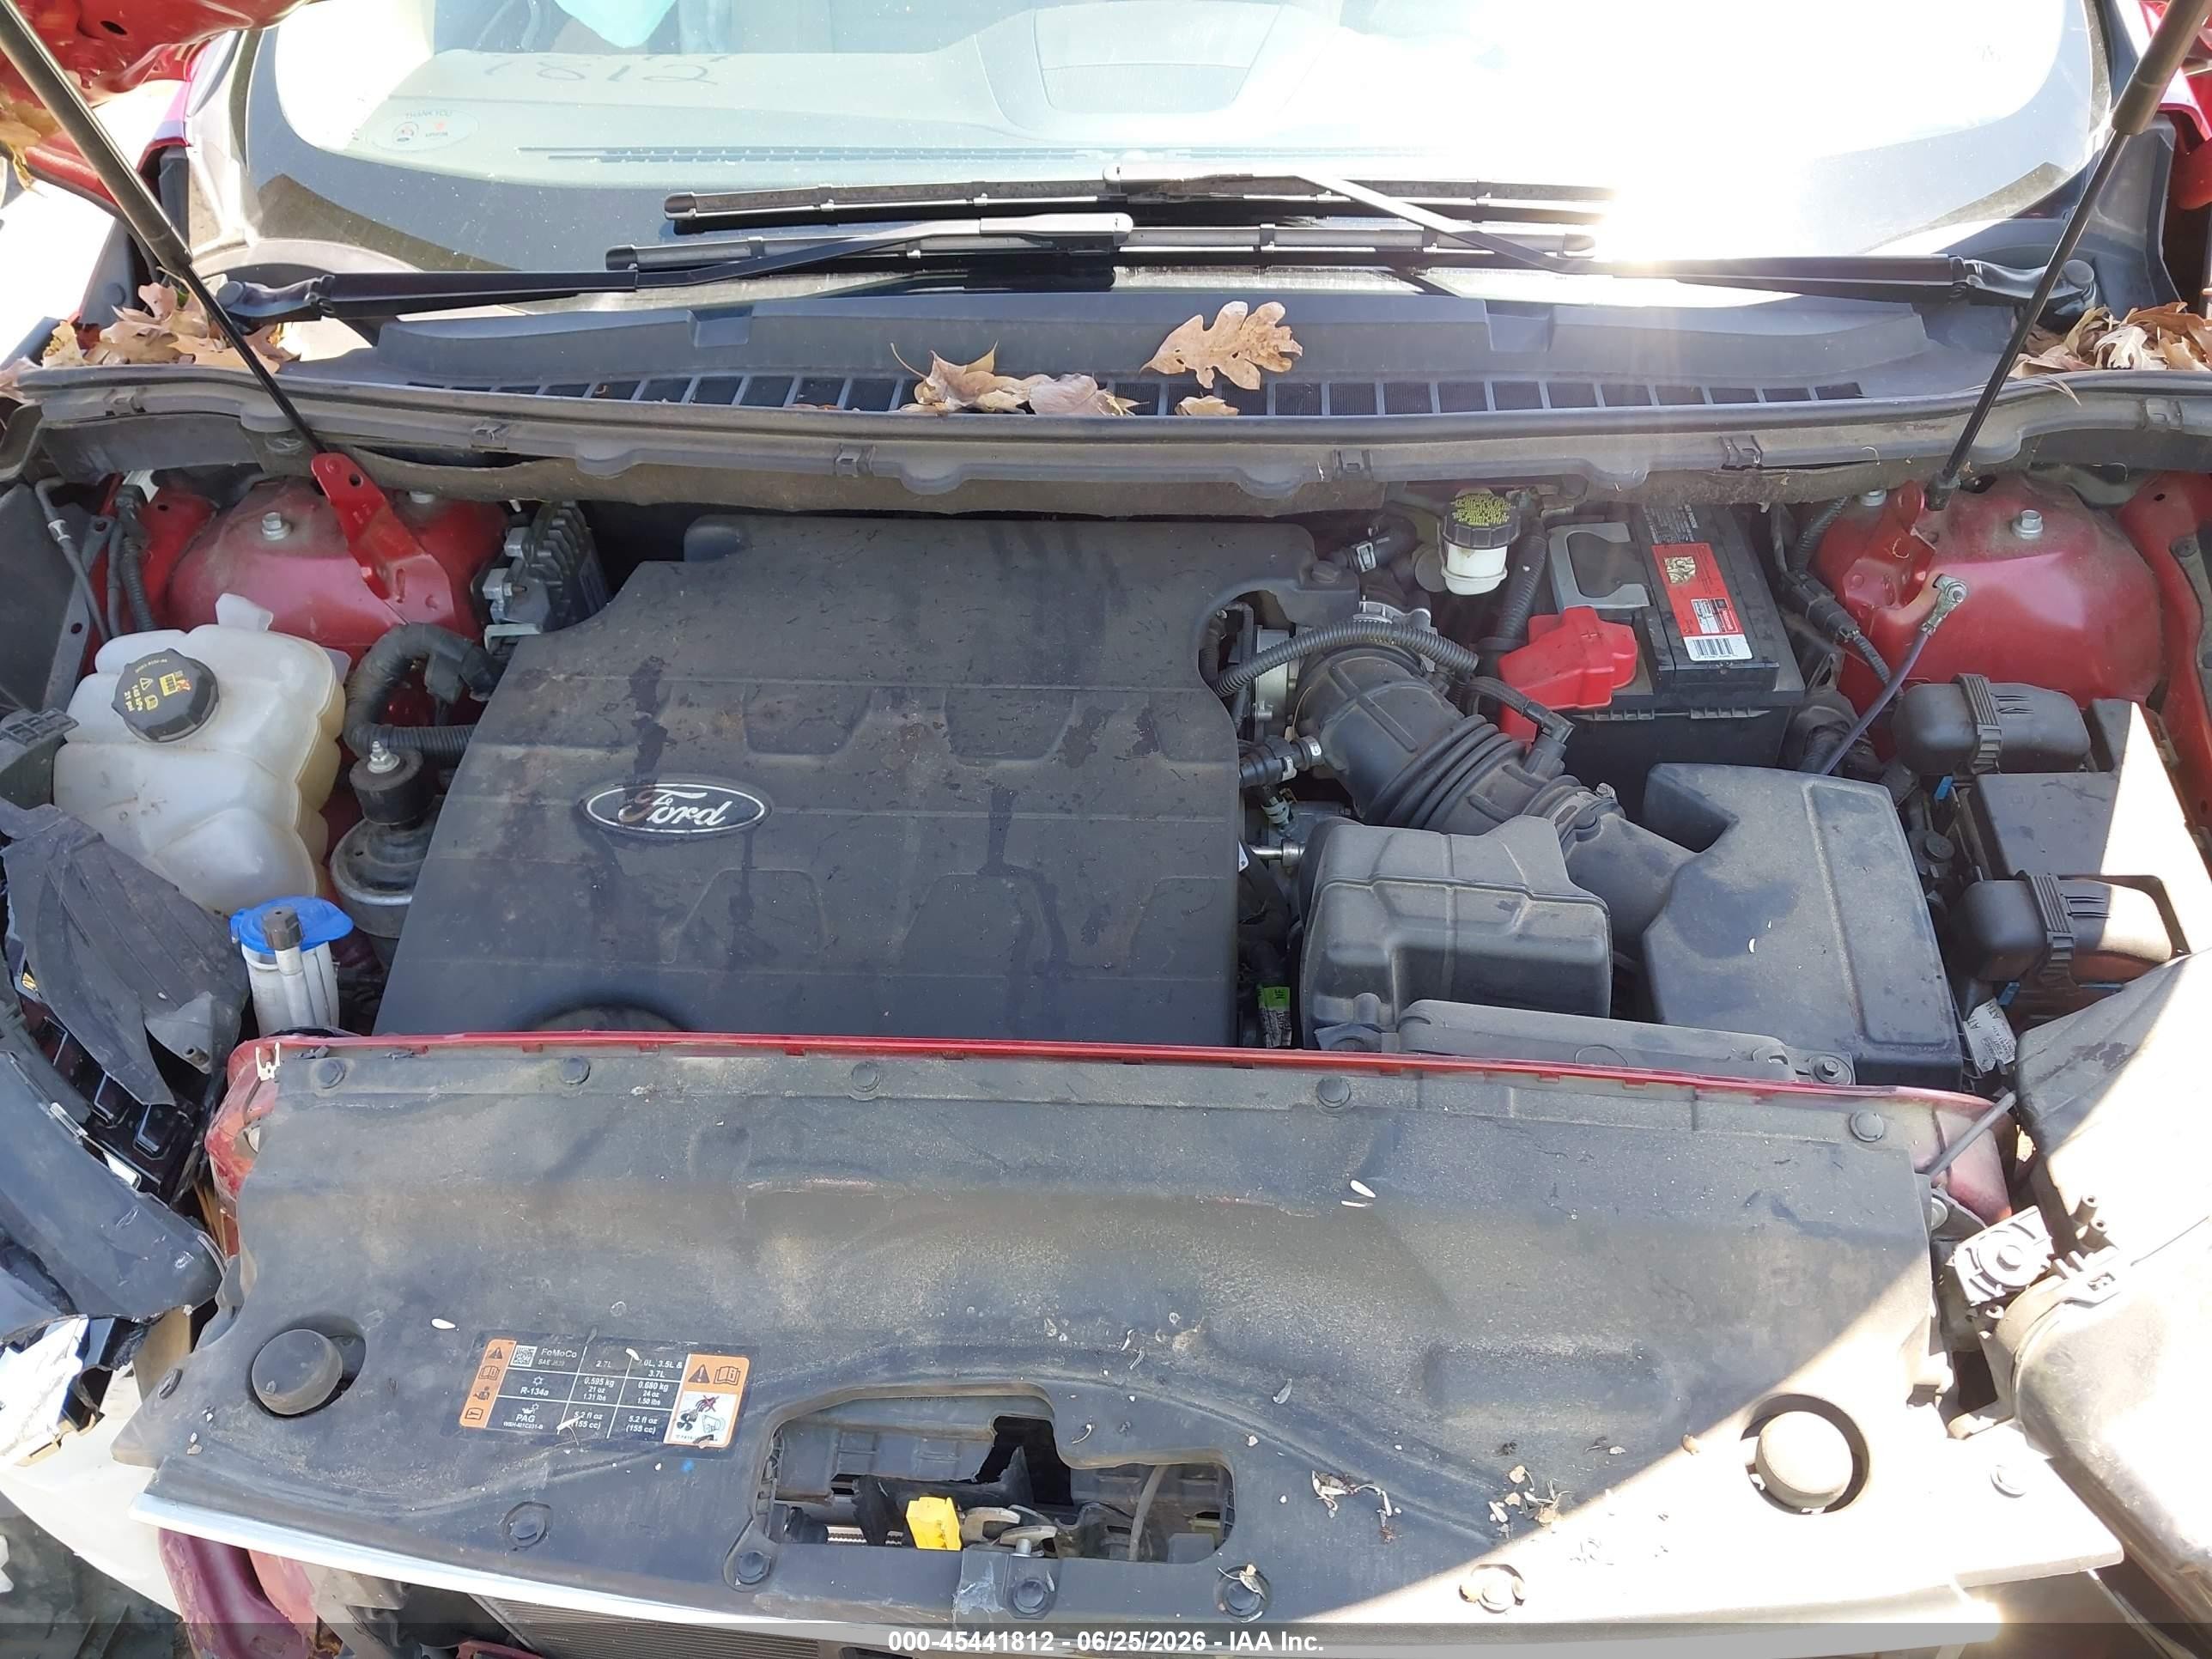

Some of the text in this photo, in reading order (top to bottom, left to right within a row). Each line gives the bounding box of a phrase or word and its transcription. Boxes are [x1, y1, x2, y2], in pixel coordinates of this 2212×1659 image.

[618, 788, 732, 826] Ford
[1986, 1002, 2000, 1019] ATH
[541, 1348, 577, 1358] FoMoCo
[658, 1360, 674, 1369] 3.5L
[648, 1370, 665, 1378] 3.7L
[584, 1376, 615, 1388] 0.595 kg
[638, 1381, 669, 1392] 0.680 kg
[520, 1387, 550, 1396] R-134a
[515, 1413, 536, 1423] PAG
[588, 1421, 601, 1431] cc)
[625, 1424, 656, 1435] (155 cc)
